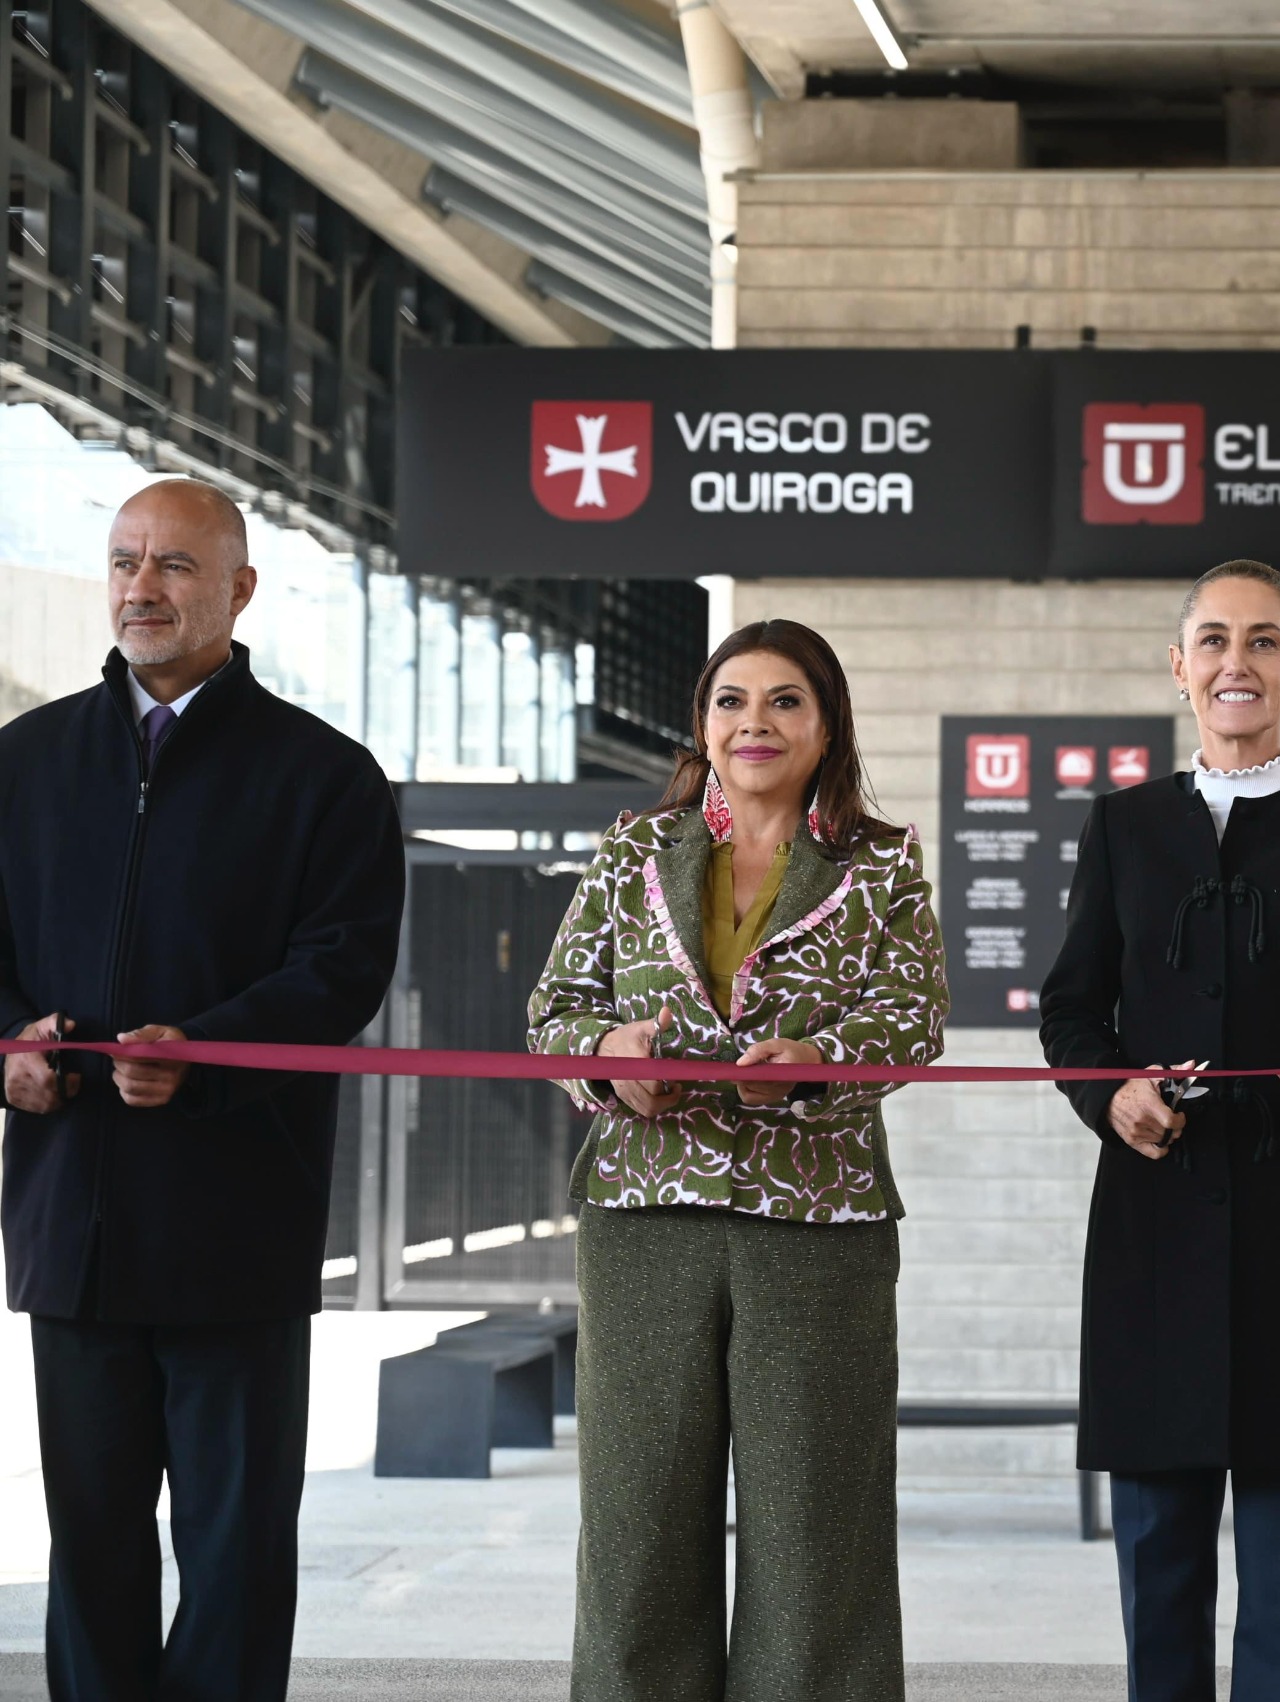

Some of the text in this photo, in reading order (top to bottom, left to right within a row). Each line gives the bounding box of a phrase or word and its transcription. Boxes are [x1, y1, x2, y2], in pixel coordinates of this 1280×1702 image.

[674, 411, 931, 454] VASCO DE
[689, 471, 914, 515] QUIROGA
